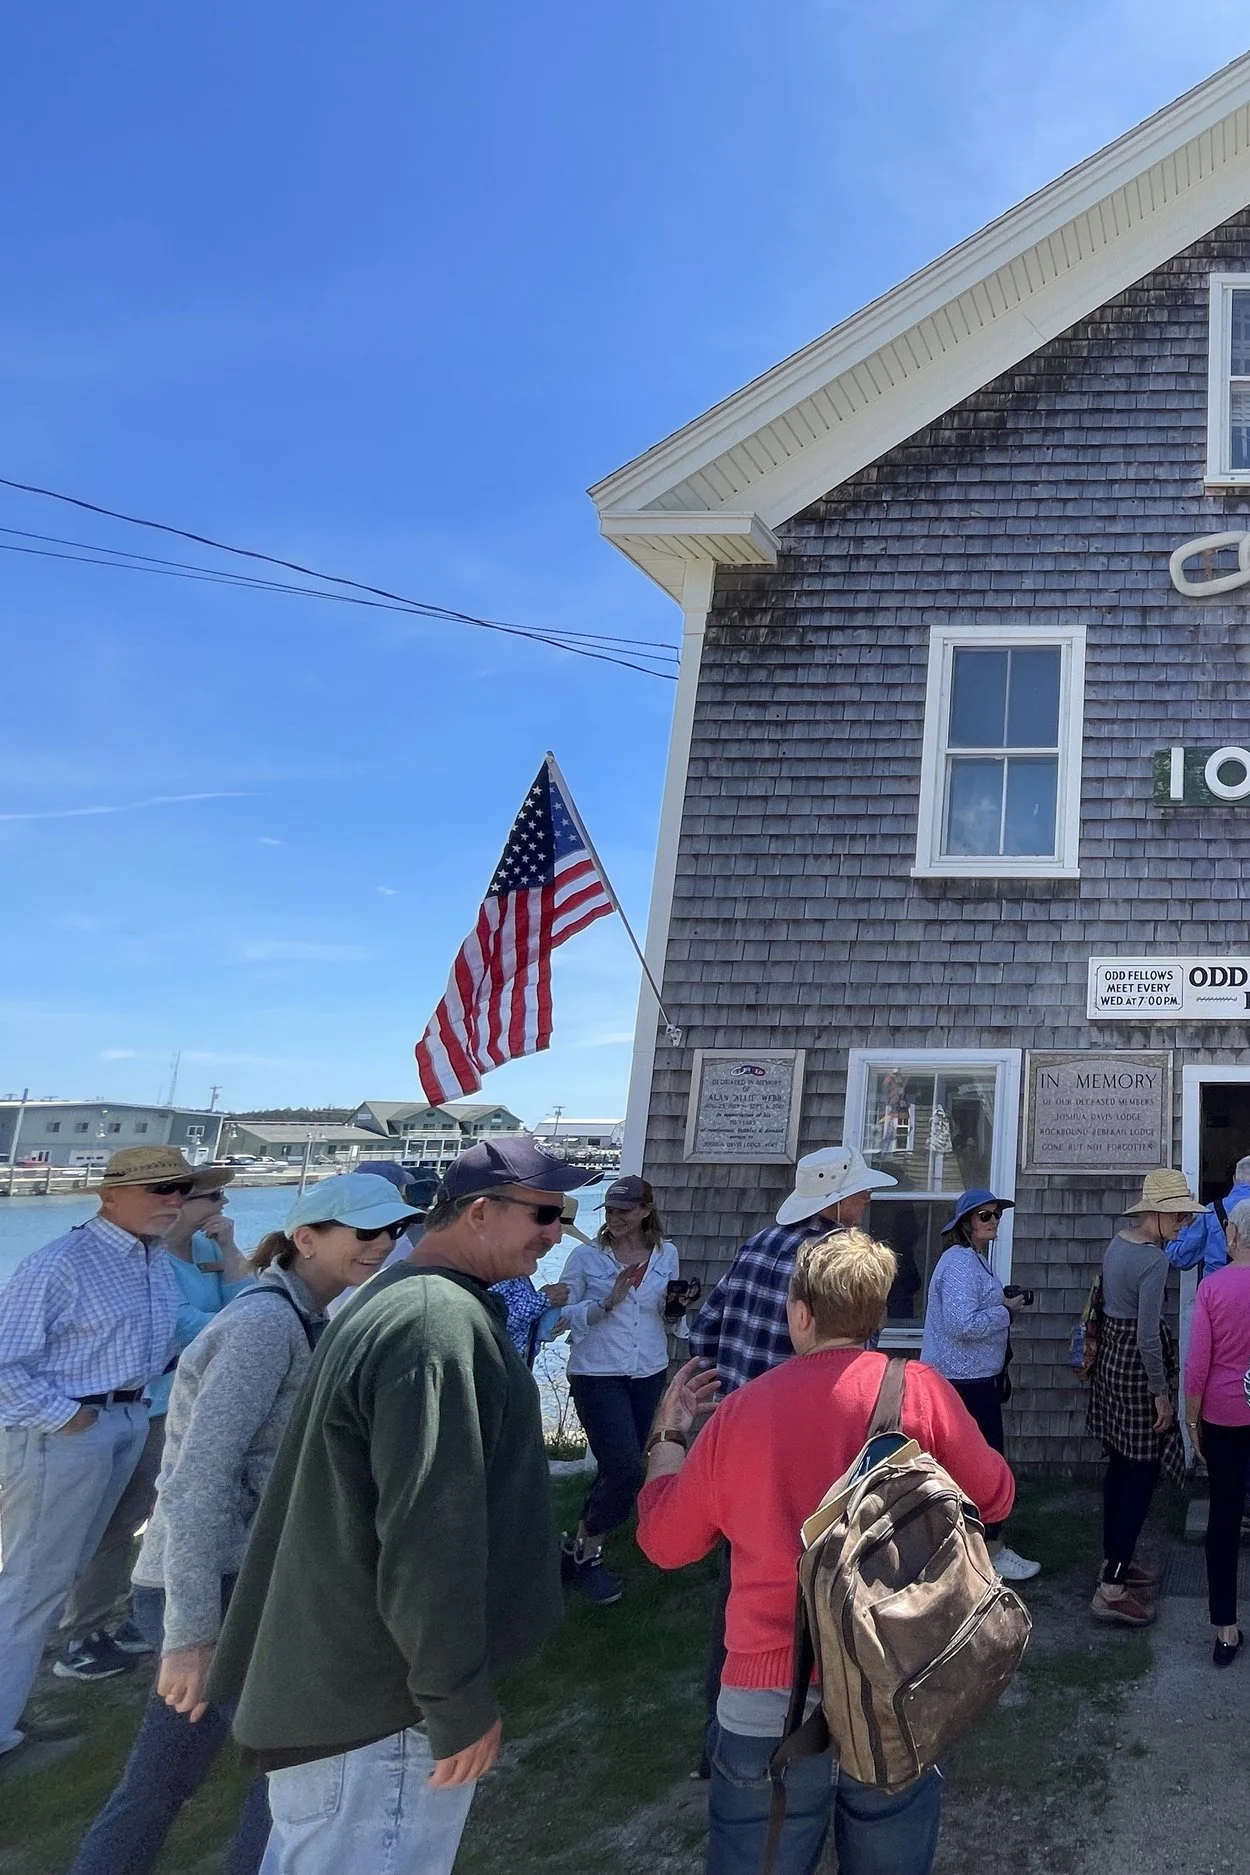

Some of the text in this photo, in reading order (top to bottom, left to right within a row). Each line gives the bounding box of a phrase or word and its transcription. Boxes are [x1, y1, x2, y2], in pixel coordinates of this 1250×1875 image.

[1105, 970, 1174, 981] ODD FELLOWS
[1188, 966, 1248, 987] ODD
[1107, 983, 1170, 992] MEET EVERY
[1041, 1073, 1157, 1089] IN MEMORY
[1054, 1113, 1142, 1121] JOSHUA DAVIS LODGE
[1040, 1128, 1155, 1136] ROCKBOUND REBEKAH LODGE
